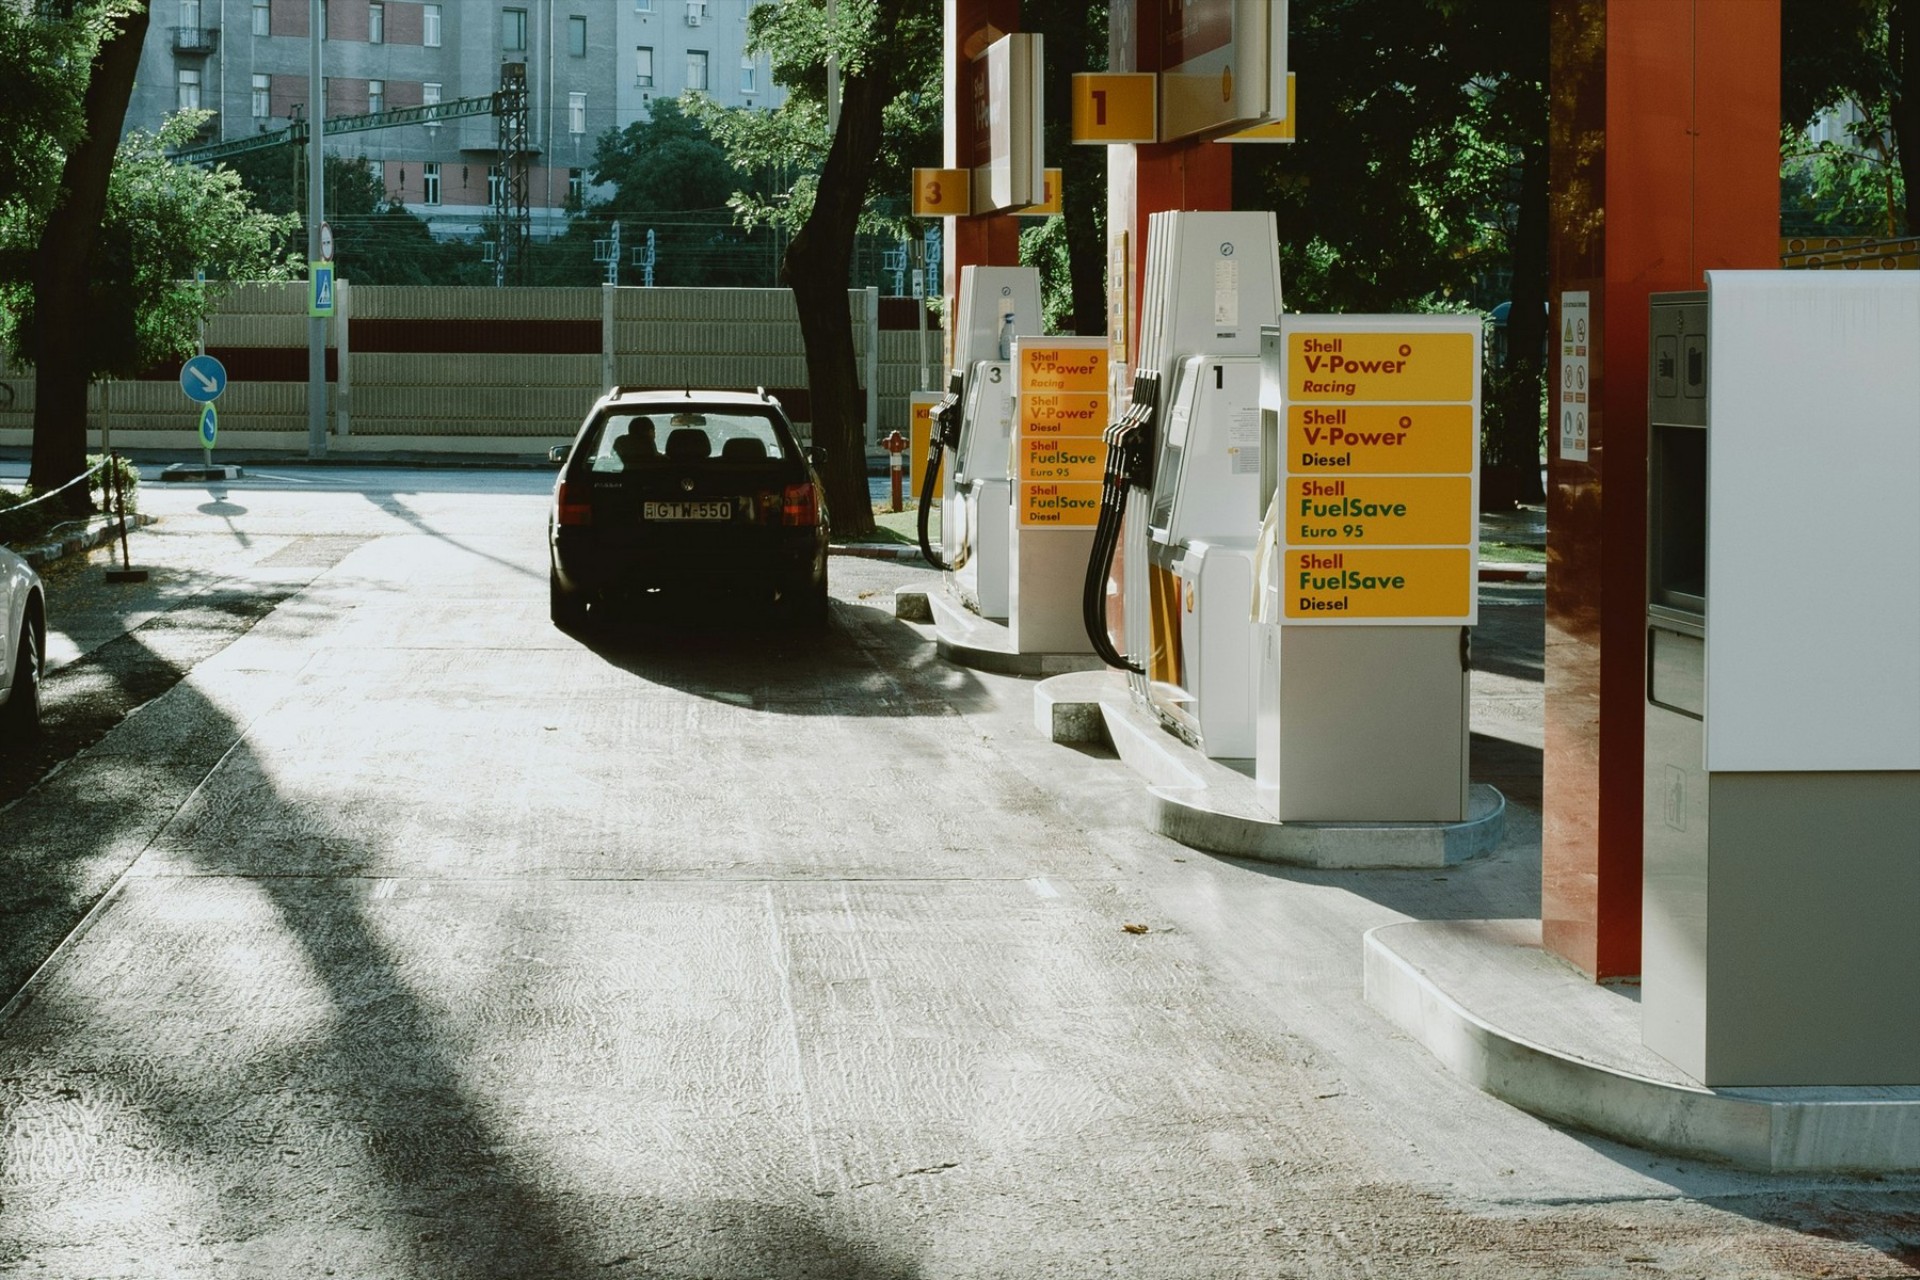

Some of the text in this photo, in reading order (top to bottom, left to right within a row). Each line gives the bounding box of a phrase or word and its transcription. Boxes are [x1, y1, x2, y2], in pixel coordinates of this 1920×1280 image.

[1092, 90, 1106, 125] 1
[925, 181, 942, 204] 3
[1303, 338, 1342, 352] Shell
[1031, 352, 1058, 361] Shell
[1030, 363, 1095, 374] V-Power
[1303, 355, 1406, 373] V-Power
[989, 367, 1002, 384] 3
[1213, 365, 1223, 389] 1
[1030, 379, 1065, 389] Racing
[1303, 380, 1356, 396] Racing
[1031, 396, 1058, 406] Shell
[1030, 407, 1095, 419] V-Power
[1303, 409, 1346, 424] Shell
[1030, 423, 1061, 431] Diesel
[1303, 427, 1407, 445] V-Power
[1031, 441, 1058, 450] Shell
[1030, 452, 1096, 463] FuelSave
[1302, 452, 1351, 466] Diesel
[1030, 468, 1069, 476] Euro 95
[1030, 486, 1058, 495] Shell
[1302, 481, 1345, 496] Shell
[1030, 496, 1096, 508] FuelSave
[1301, 497, 1407, 517] FuelSave
[657, 503, 730, 518] GTW-550
[1029, 512, 1061, 521] Diesel
[1301, 524, 1364, 538] Euro 95
[1300, 553, 1343, 569] Shell
[1300, 570, 1405, 590] FuelSave
[1300, 596, 1348, 610] Diesel
